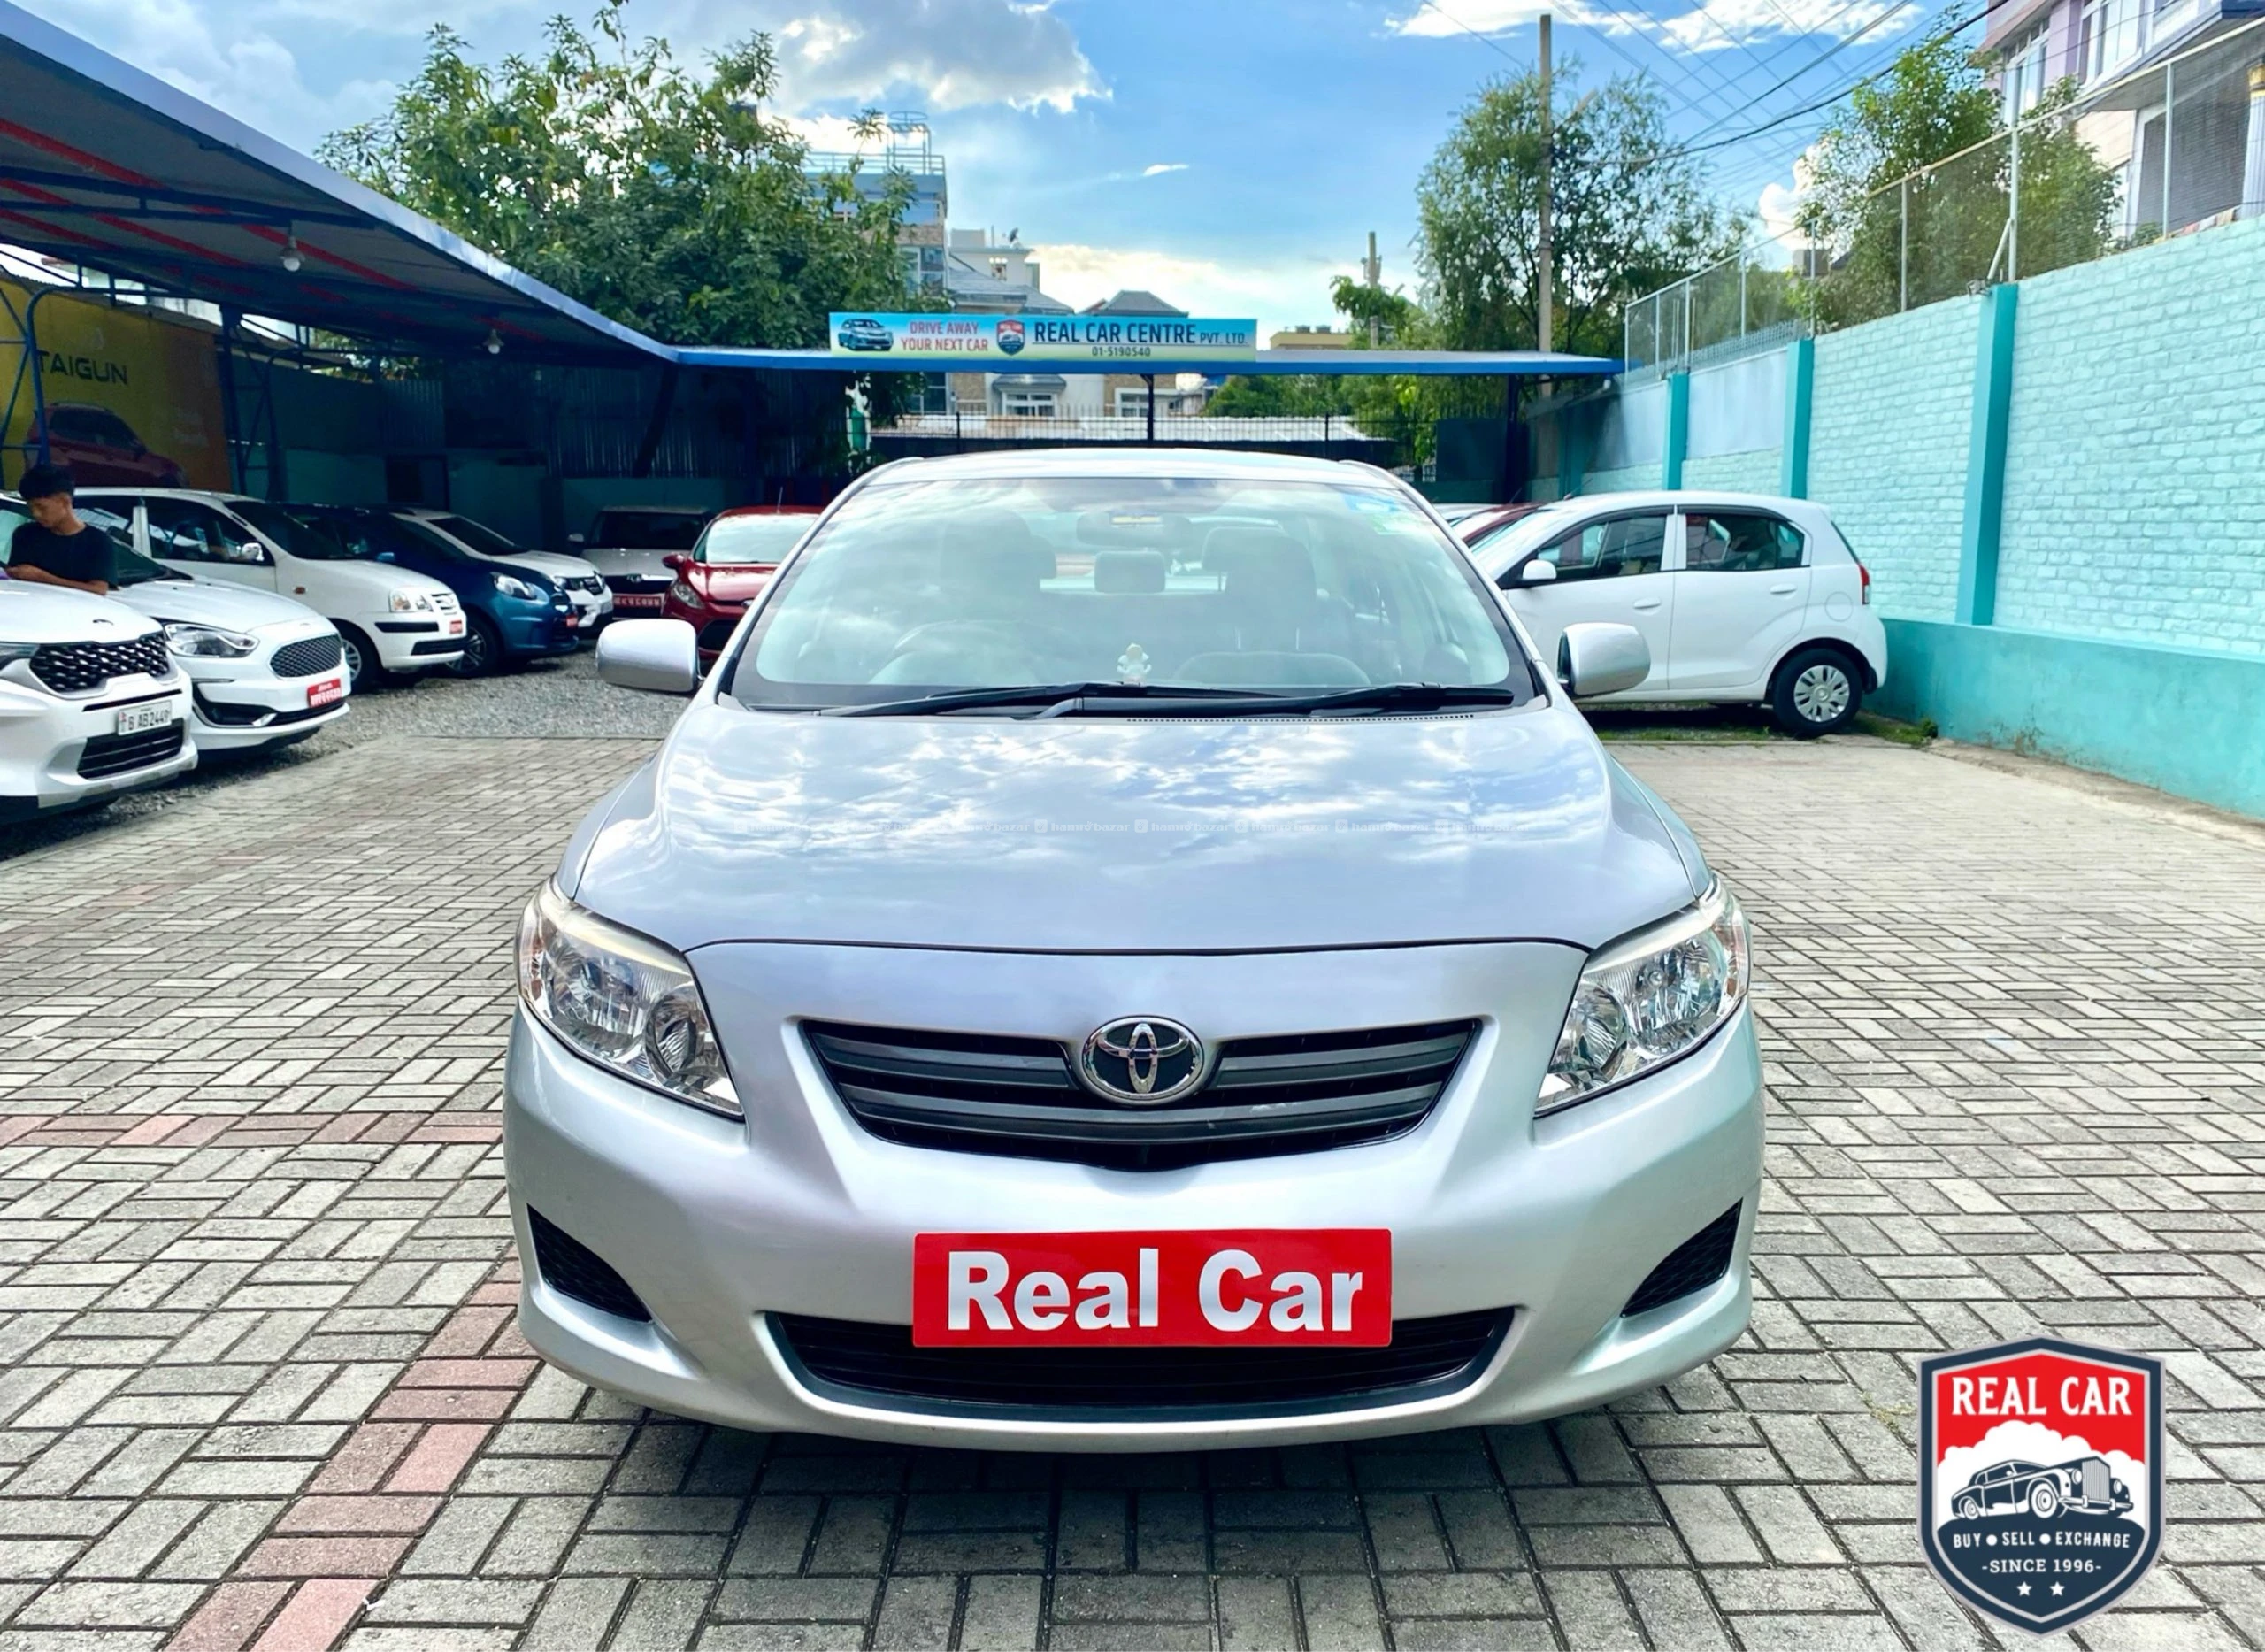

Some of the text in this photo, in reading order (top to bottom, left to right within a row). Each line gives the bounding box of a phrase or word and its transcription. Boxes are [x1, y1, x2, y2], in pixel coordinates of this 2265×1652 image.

[910, 321, 979, 334] DRIVE AWAY
[1034, 322, 1080, 342] REAL
[1086, 322, 1121, 343] CAR
[1127, 323, 1196, 343] CENTRE
[901, 338, 988, 351] YOUR NEXT CAR
[1091, 346, 1152, 357] 01-5190540
[36, 350, 128, 385] TAIGUN
[948, 1248, 1363, 1332] Real Car
